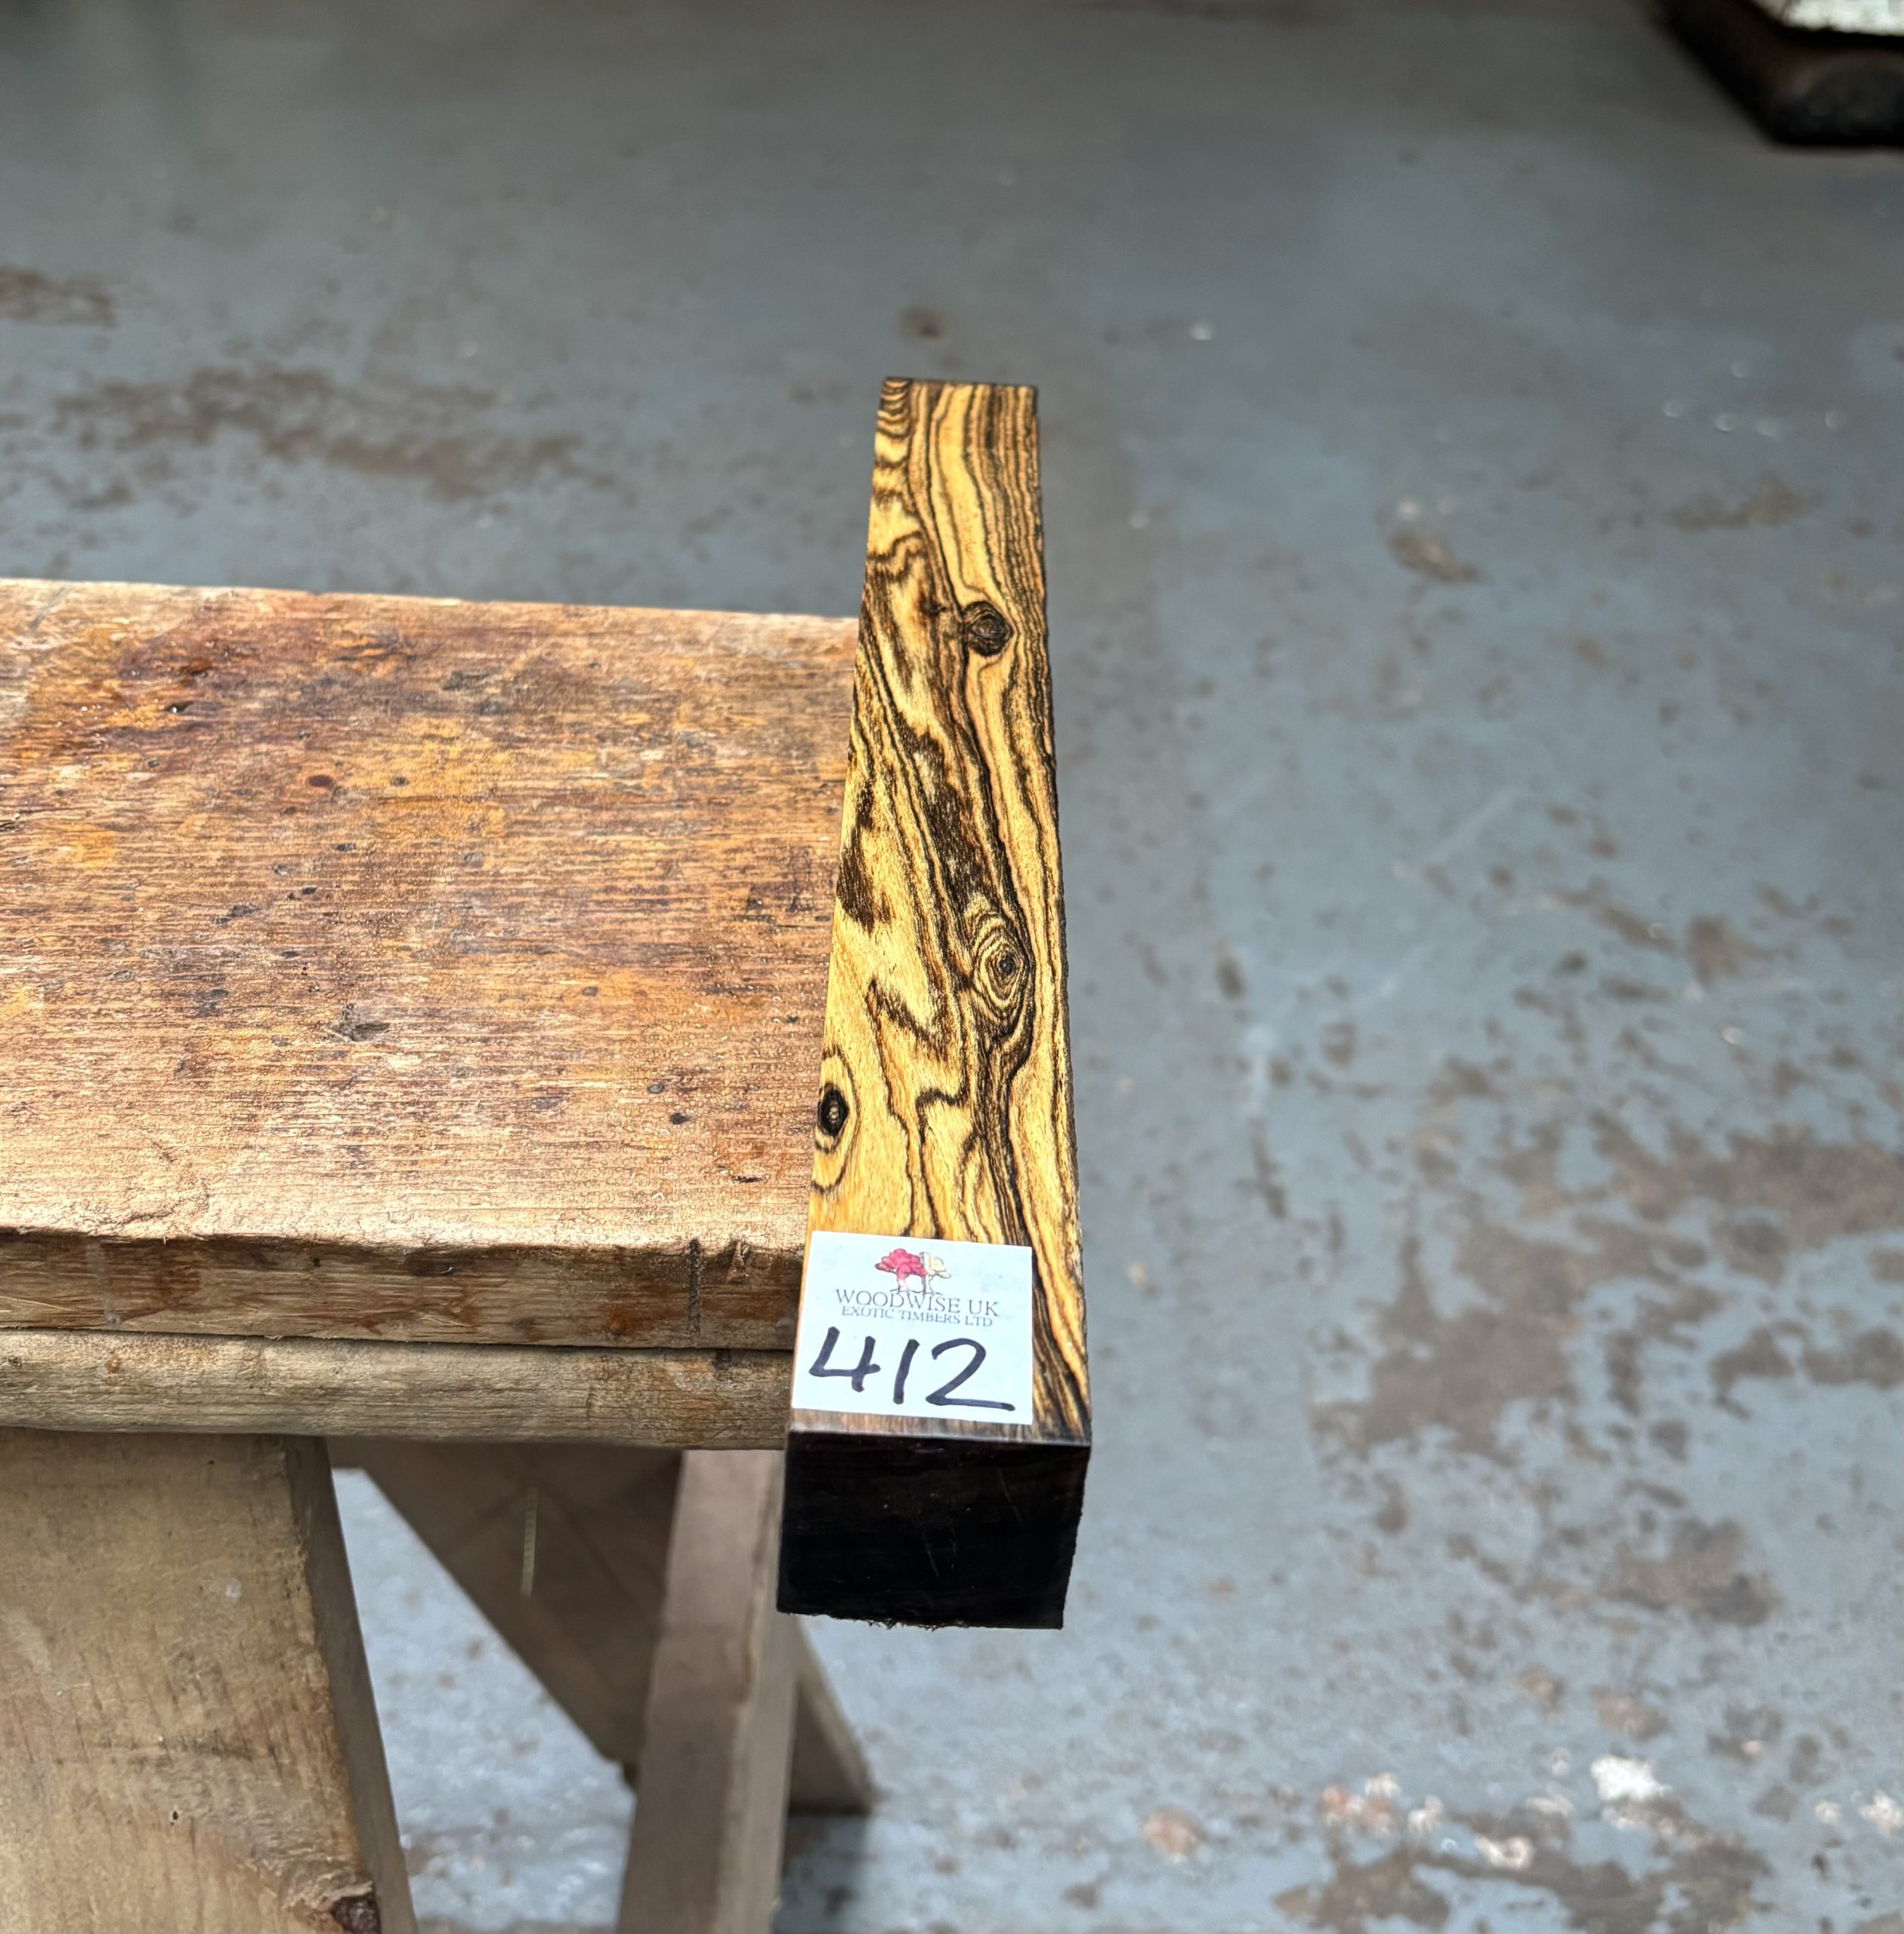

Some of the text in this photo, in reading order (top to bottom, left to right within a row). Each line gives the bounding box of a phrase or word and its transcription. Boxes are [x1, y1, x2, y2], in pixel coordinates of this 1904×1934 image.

[836, 1289, 1000, 1317] WOODWISE UK
[842, 1305, 993, 1327] EXOTIC TIMBERS LTD
[808, 1326, 1015, 1411] 412
